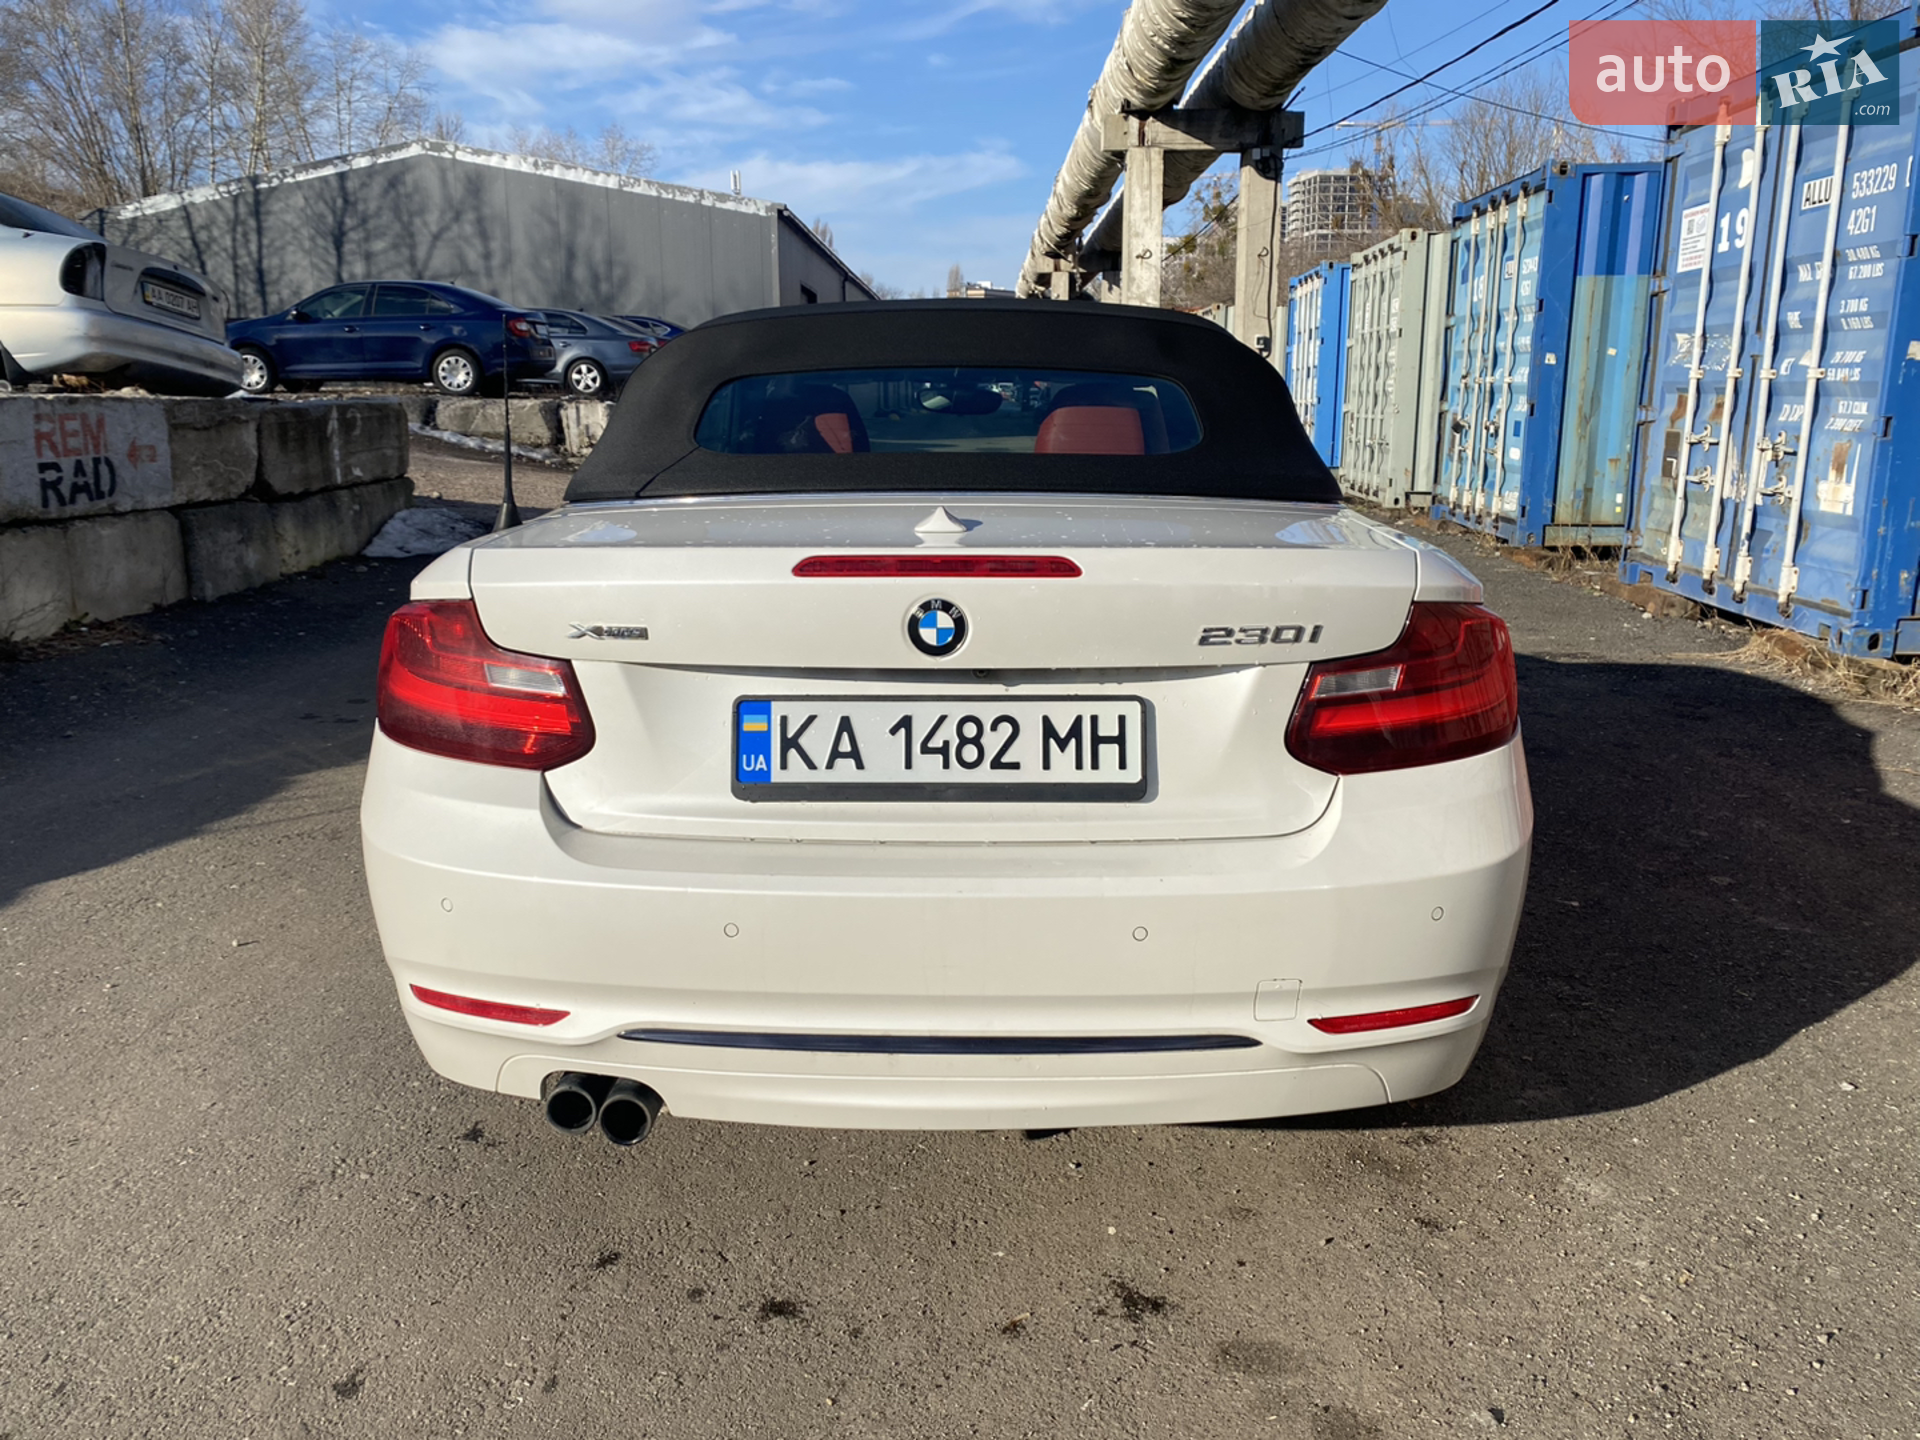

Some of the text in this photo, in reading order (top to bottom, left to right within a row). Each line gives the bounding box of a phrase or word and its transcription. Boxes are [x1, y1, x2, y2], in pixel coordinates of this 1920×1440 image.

[1804, 163, 1897, 207] ALLU 533229
[1717, 208, 1749, 253] 19
[1847, 205, 1877, 235] 42G1
[34, 412, 108, 459] REM
[37, 456, 117, 508] RAD
[914, 600, 961, 619] BMW
[742, 754, 768, 772] UA
[779, 714, 1127, 771] KA 1482 MH
